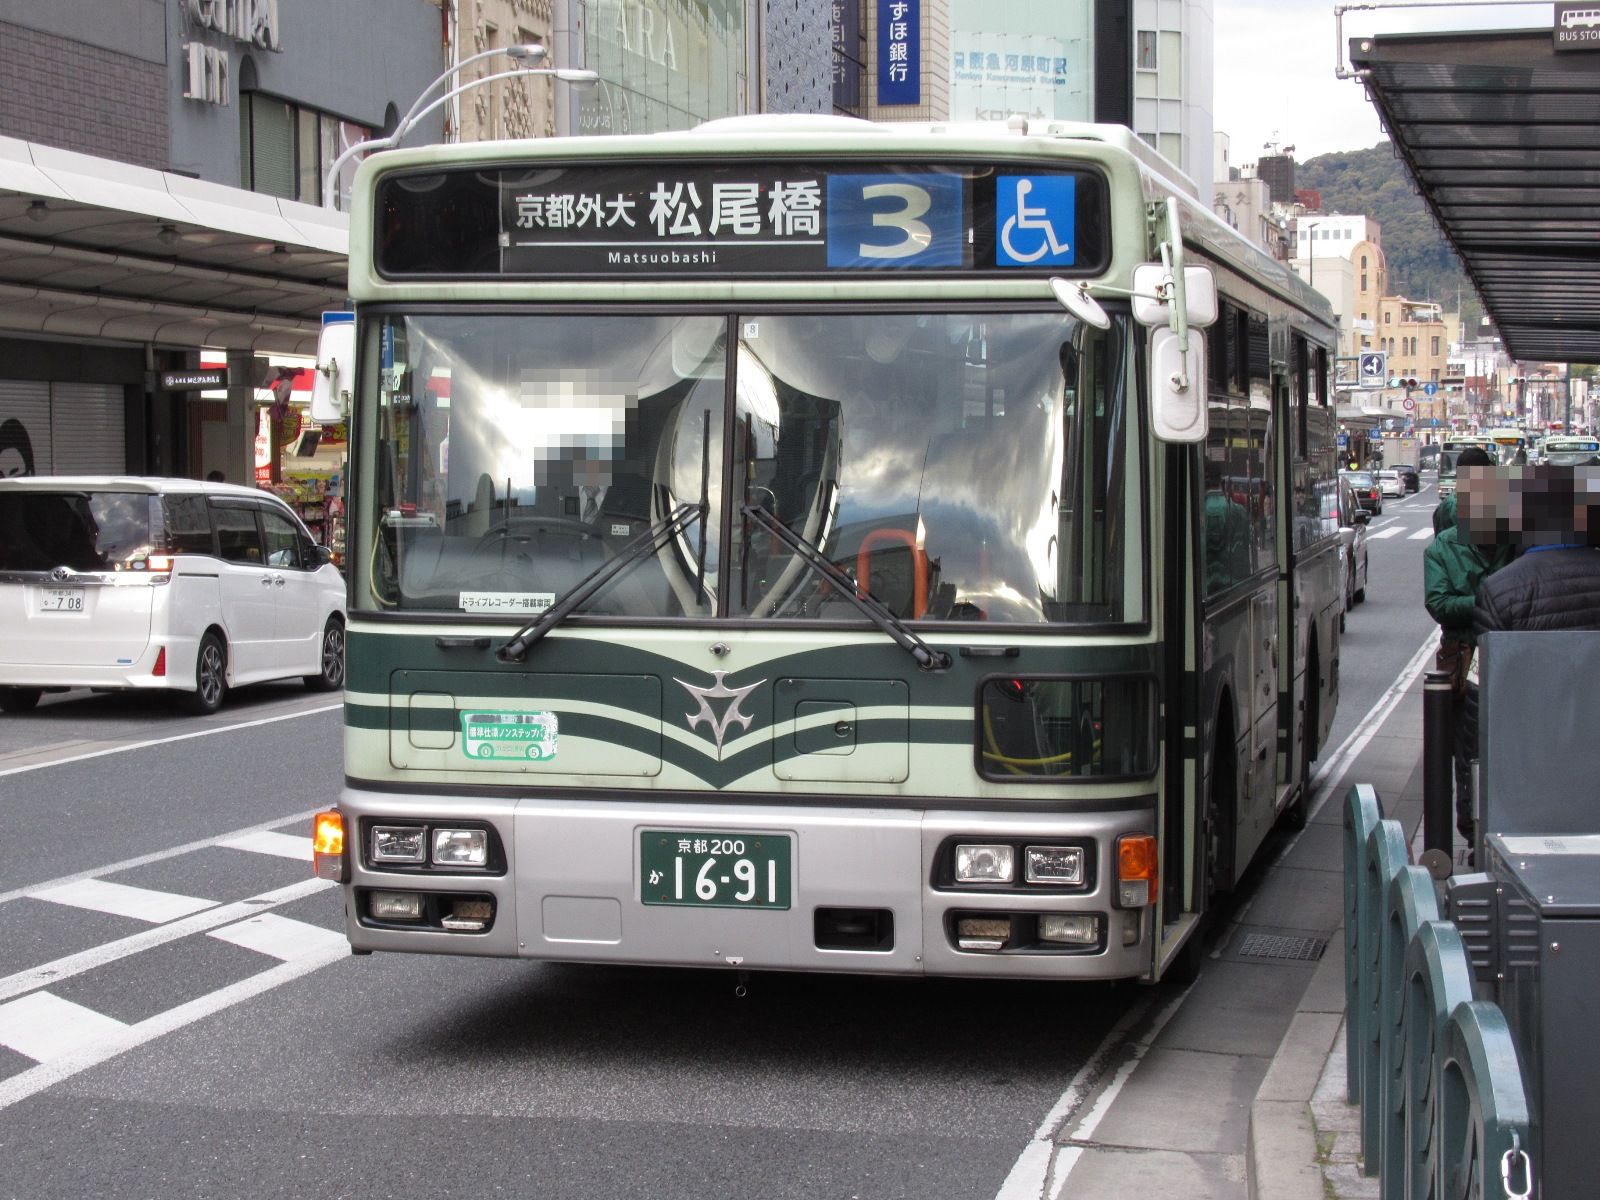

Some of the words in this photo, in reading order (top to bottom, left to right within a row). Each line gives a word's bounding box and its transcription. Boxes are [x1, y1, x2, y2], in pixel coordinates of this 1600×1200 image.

[889, 2, 908, 81] ずほ銀行
[1560, 31, 1577, 41] BUS
[1580, 30, 1600, 41] STO
[515, 194, 636, 228] 京都外大
[649, 180, 821, 237] 松尾橋
[859, 183, 931, 258] 3
[608, 252, 717, 264] Matsuobashi
[678, 839, 708, 853] 京都
[711, 840, 745, 855] 200
[649, 870, 664, 885] か
[675, 857, 776, 902] 16-91
